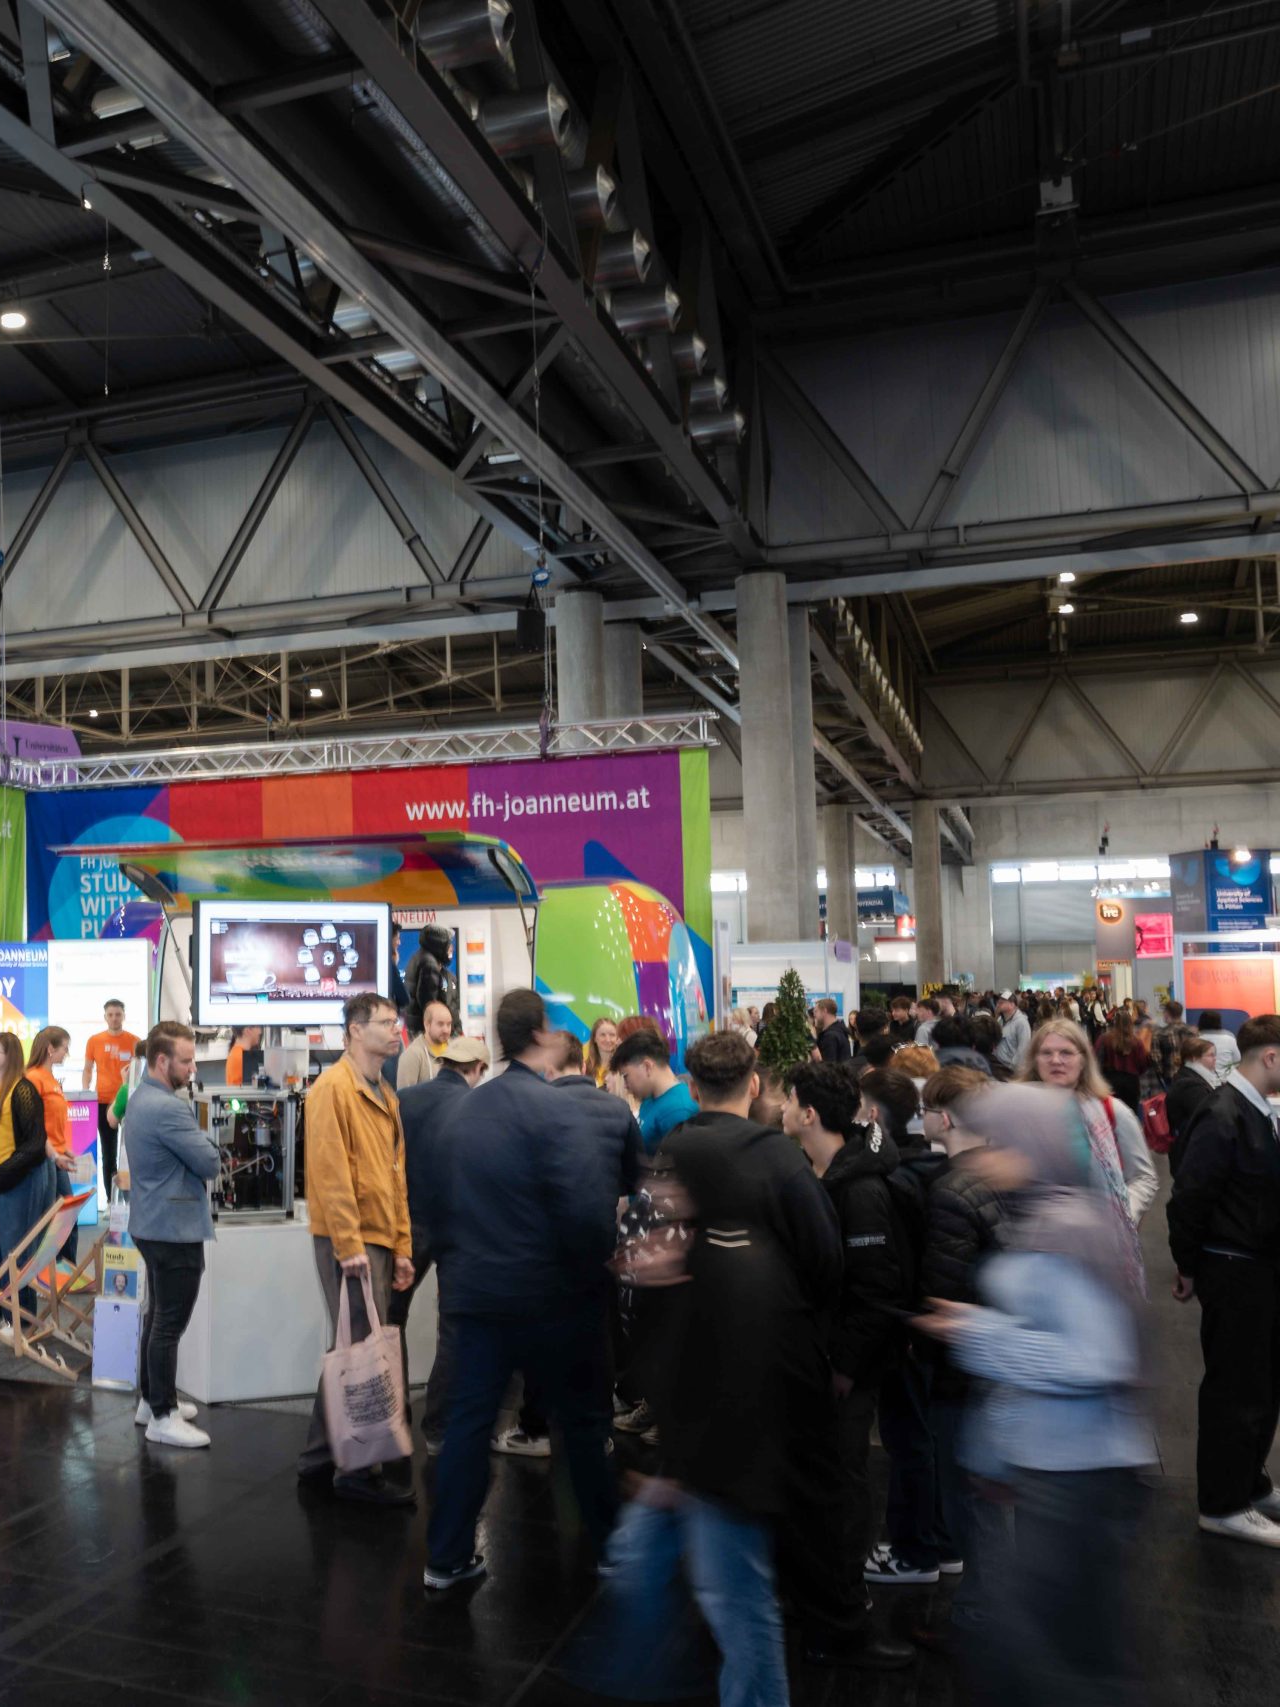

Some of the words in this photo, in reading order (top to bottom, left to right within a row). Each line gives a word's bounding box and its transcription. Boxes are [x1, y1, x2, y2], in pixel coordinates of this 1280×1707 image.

[405, 785, 651, 822] www.fh-joanneum.at
[80, 872, 140, 894] STUD
[392, 910, 437, 924] NNEUM
[66, 1106, 90, 1118] NEUM
